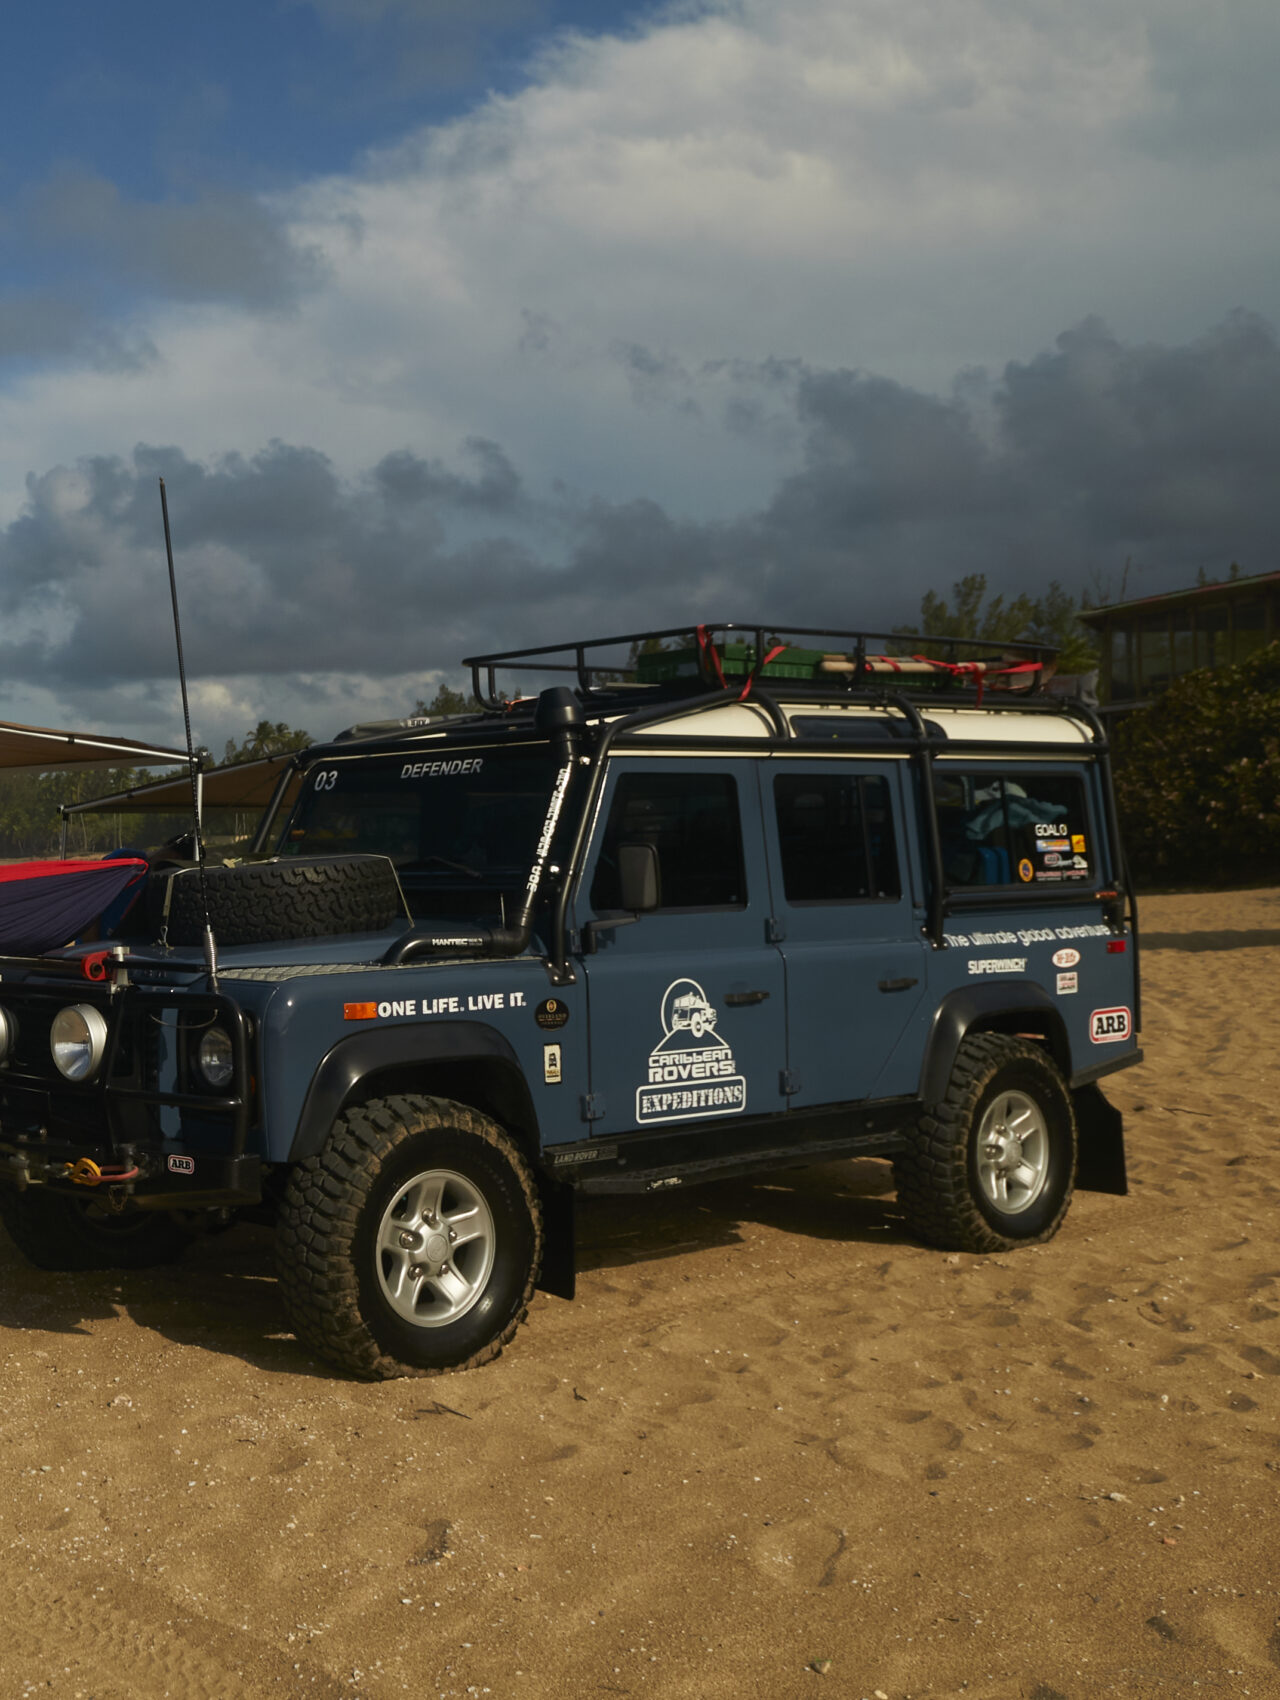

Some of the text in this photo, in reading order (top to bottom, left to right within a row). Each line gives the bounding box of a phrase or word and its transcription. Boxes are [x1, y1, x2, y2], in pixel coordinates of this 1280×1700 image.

[400, 758, 483, 779] DEFENDER
[314, 770, 338, 791] 03
[942, 924, 1111, 947] The ultimate global adventure
[377, 1000, 417, 1018] ONE
[422, 997, 465, 1014] LIFE.
[468, 993, 504, 1011] LIVE
[1095, 1014, 1126, 1035] ARB
[648, 1060, 732, 1083] ROVERS
[642, 1085, 742, 1113] EXPEDITIONS
[171, 1158, 191, 1170] ARB
[554, 1150, 599, 1164] LAND ROVER
